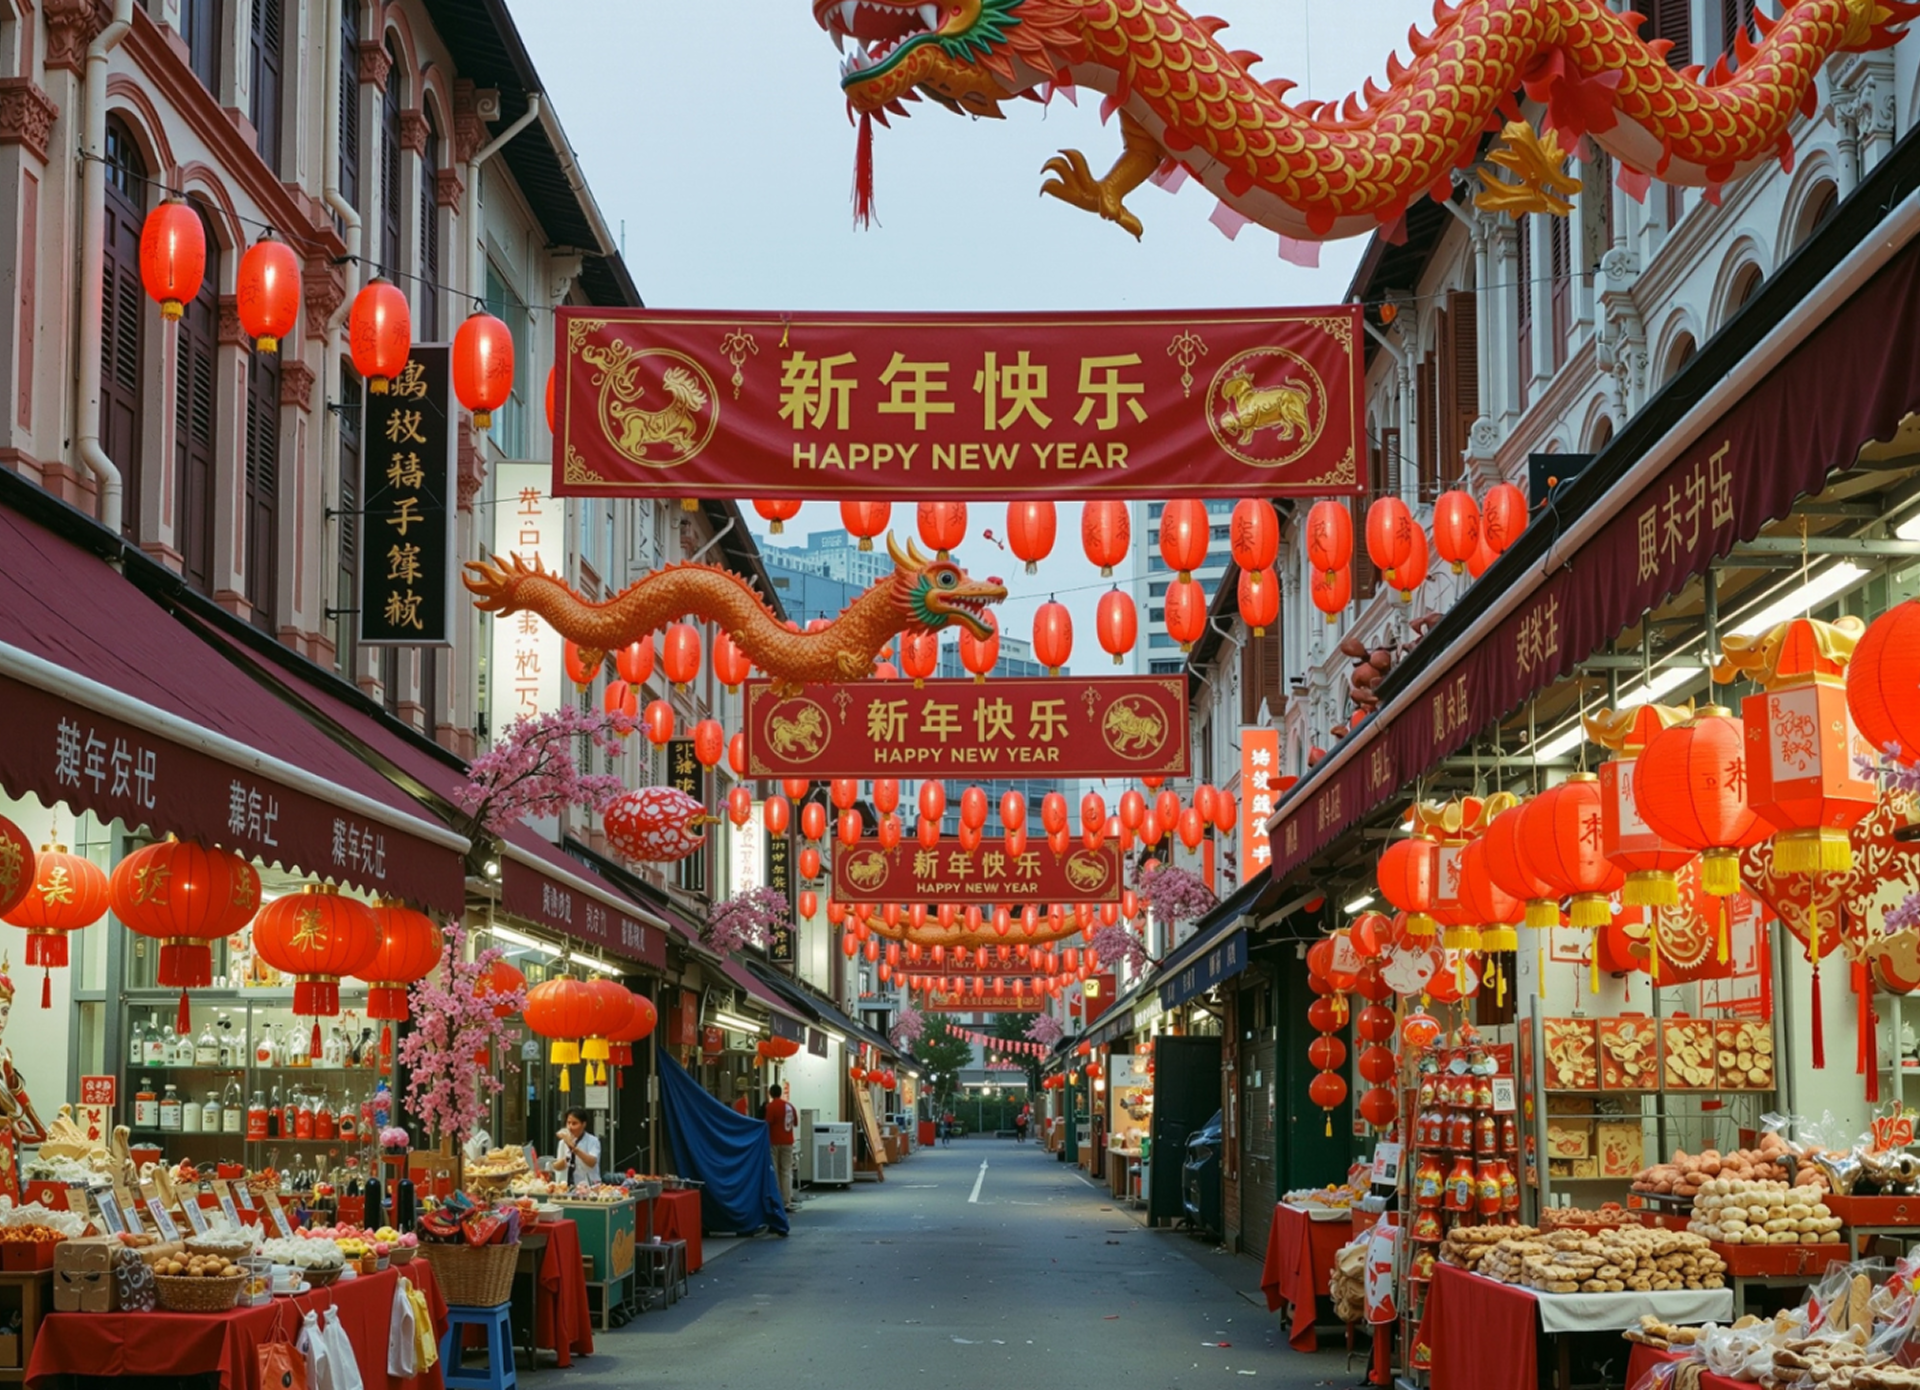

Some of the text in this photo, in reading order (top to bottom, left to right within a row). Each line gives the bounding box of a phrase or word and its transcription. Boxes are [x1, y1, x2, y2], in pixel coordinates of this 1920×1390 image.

[792, 442, 1129, 470] HAPPY NEW YEAR
[874, 746, 1060, 763] HAPPY NEW YEAR
[916, 882, 1039, 893] HAPPY NEW YEAR
